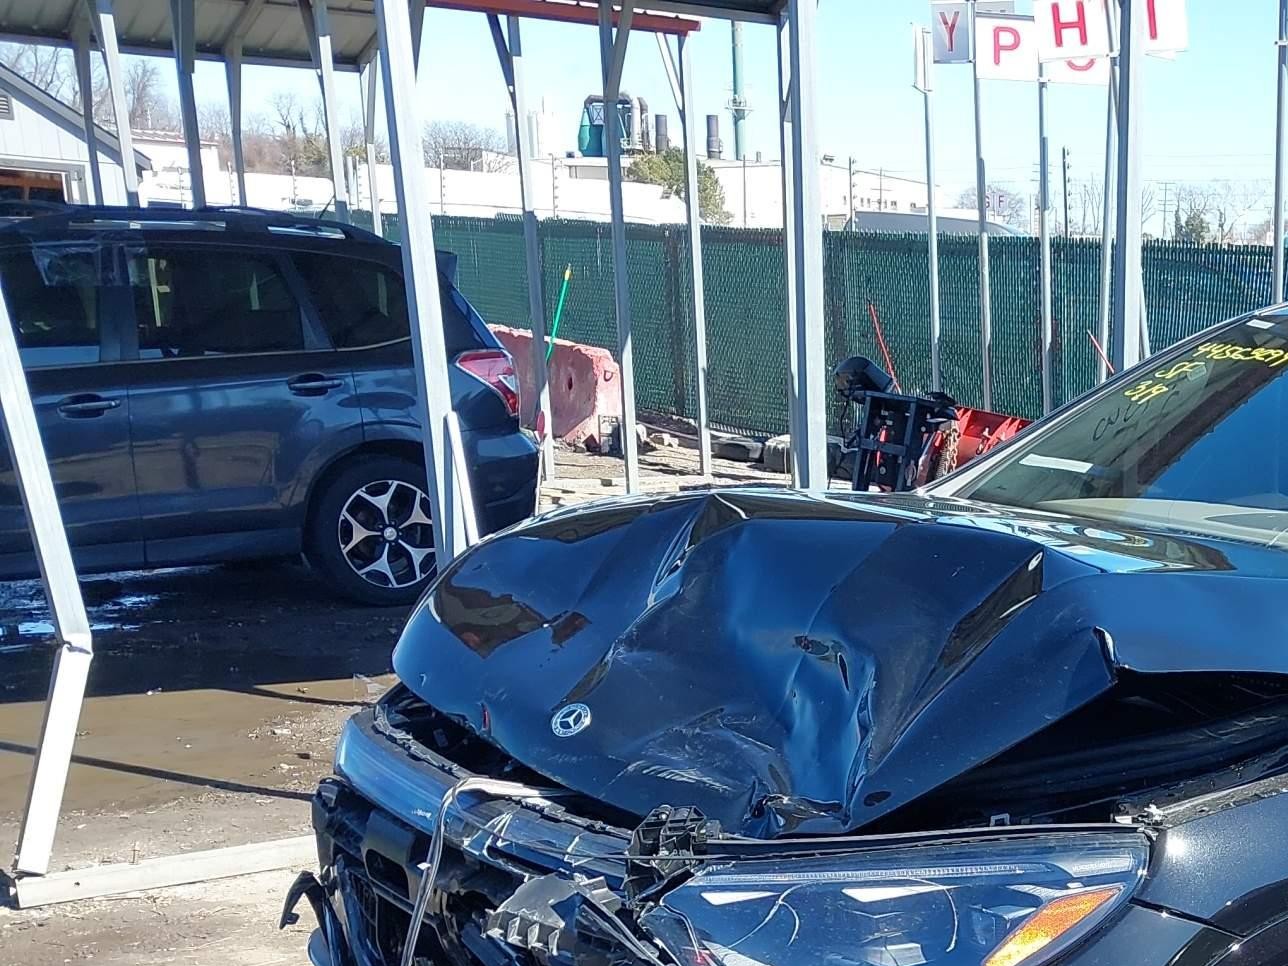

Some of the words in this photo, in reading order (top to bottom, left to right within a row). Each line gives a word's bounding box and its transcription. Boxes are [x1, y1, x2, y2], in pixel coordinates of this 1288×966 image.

[939, 10, 960, 52] Y
[1050, 1, 1088, 48] H
[992, 26, 1021, 66] P
